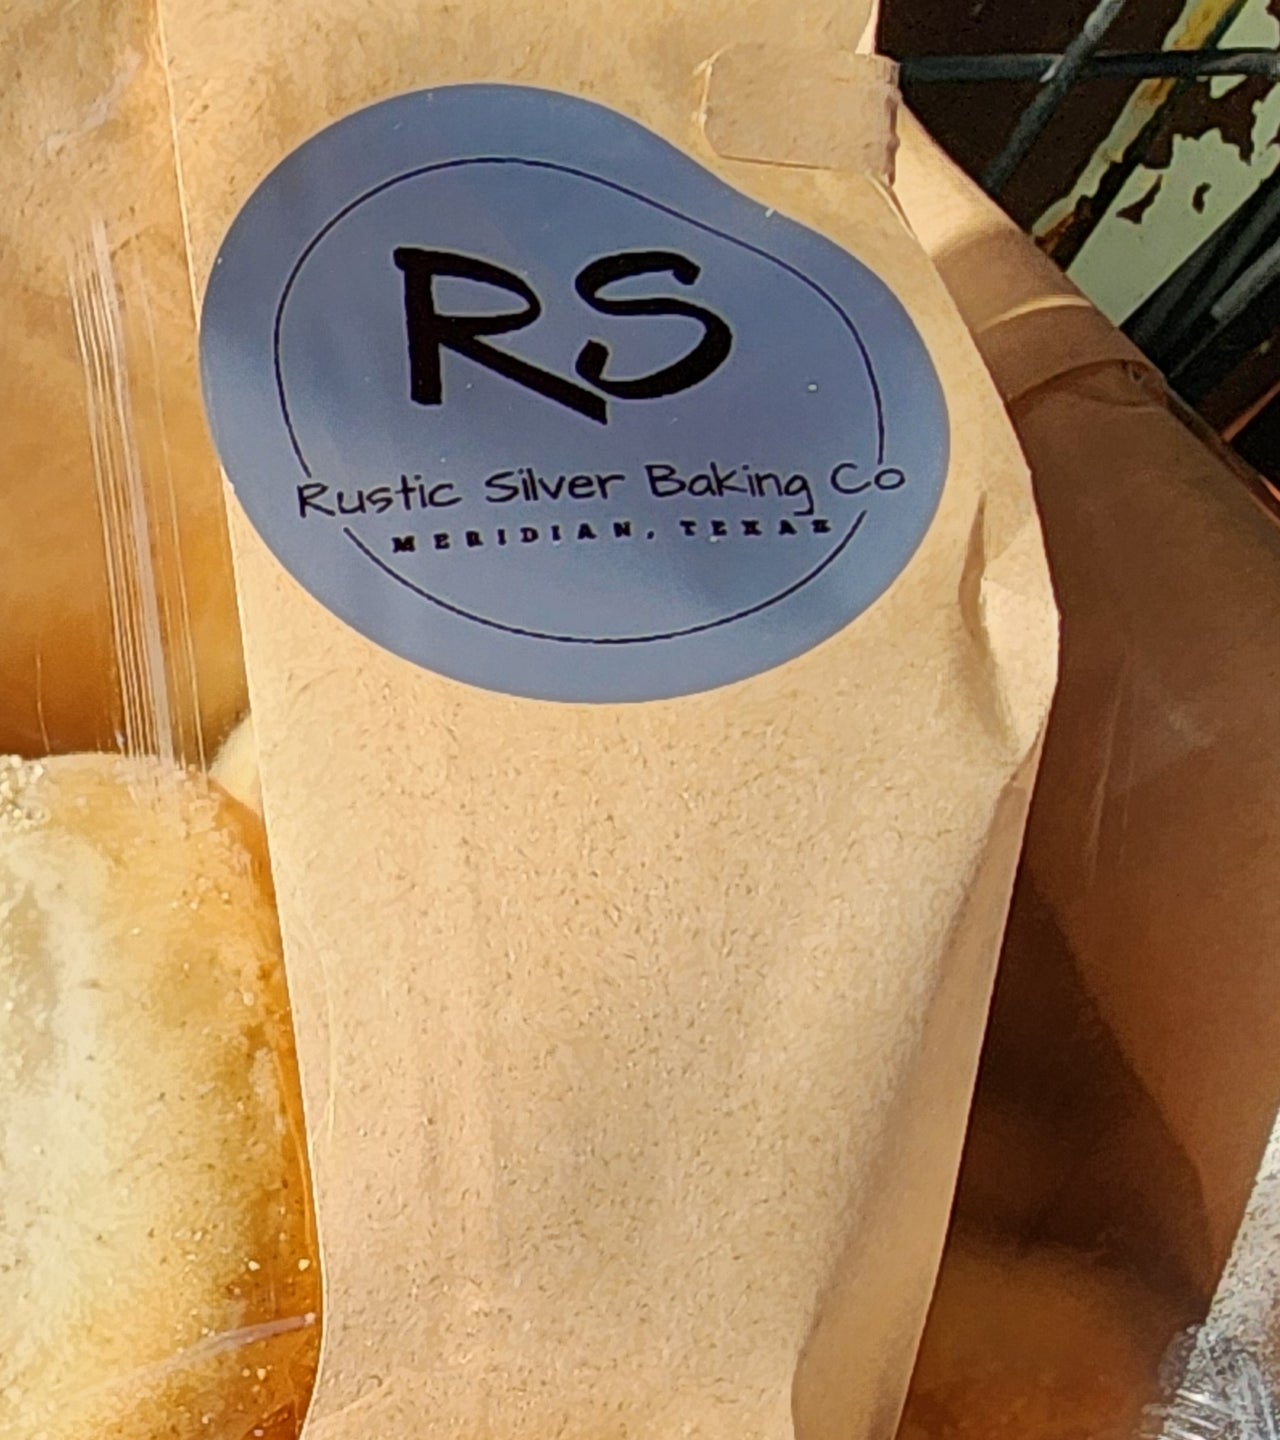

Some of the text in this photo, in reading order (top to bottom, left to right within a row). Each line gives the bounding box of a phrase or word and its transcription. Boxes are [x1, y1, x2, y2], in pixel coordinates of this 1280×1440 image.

[393, 247, 732, 425] RS
[297, 461, 906, 518] Rustic Silver Baking Co
